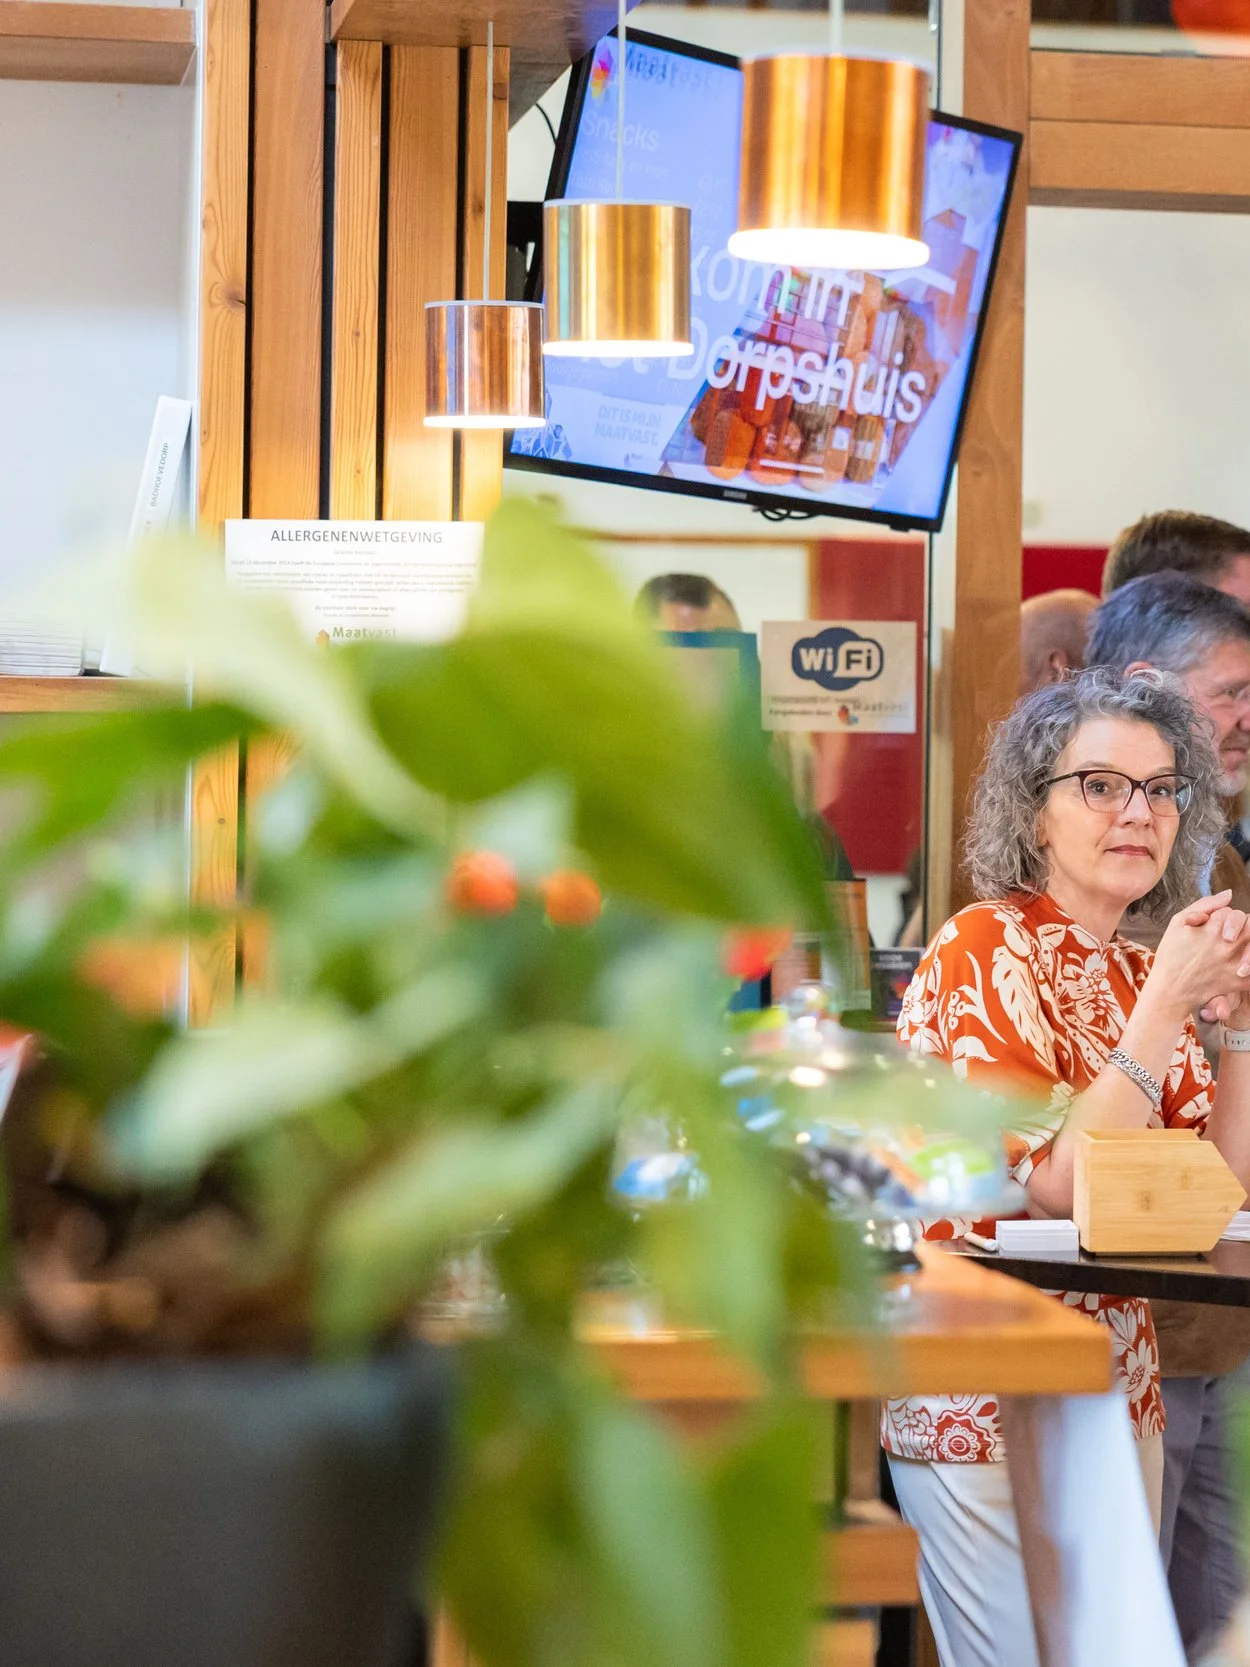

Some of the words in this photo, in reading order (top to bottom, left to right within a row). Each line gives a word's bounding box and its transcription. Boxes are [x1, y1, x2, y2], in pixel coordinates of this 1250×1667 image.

[667, 317, 926, 424] Dorpshuis
[270, 530, 443, 543] ALLERGENENWETGEVING
[332, 626, 397, 639] Maatvast
